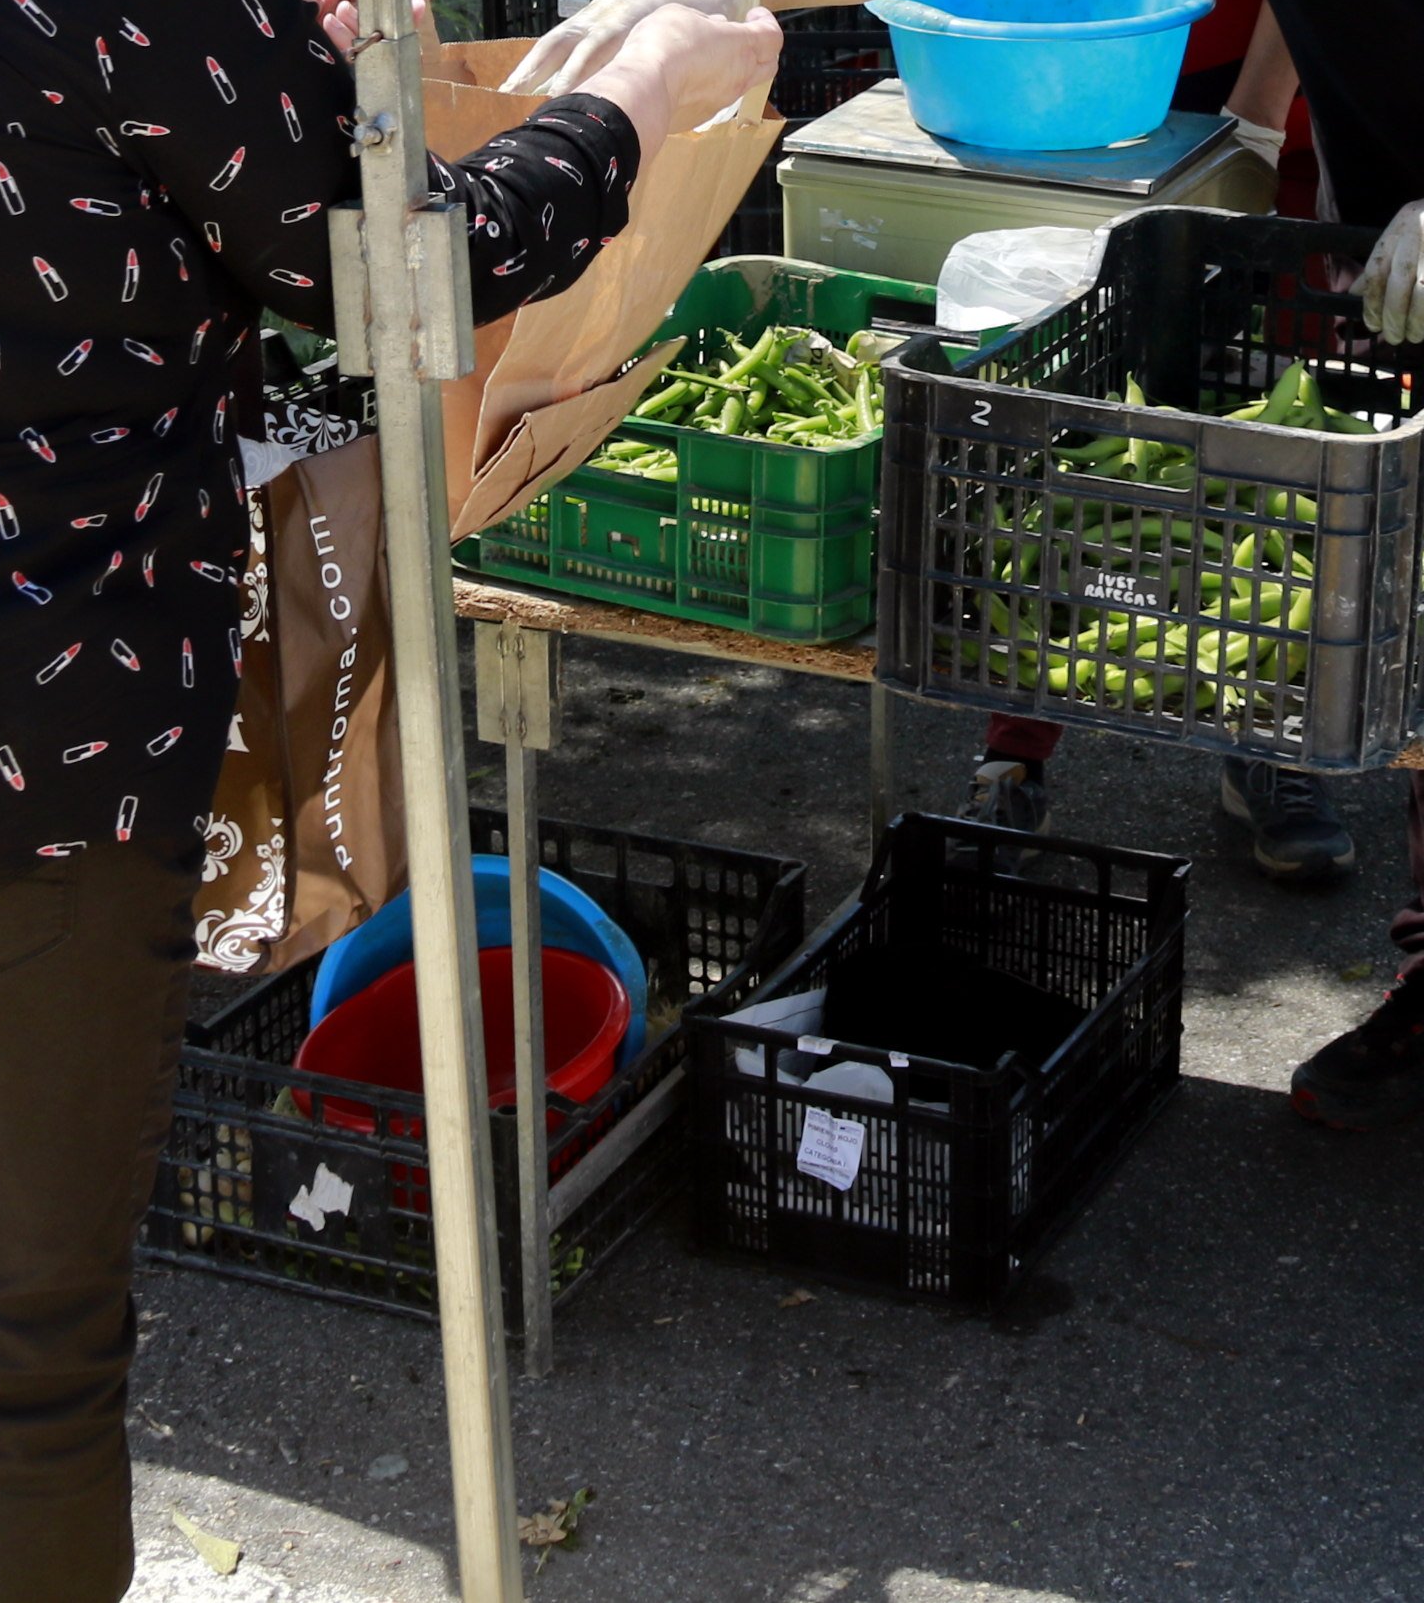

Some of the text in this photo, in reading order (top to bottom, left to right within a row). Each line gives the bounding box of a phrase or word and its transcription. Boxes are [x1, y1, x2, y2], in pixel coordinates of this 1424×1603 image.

[970, 399, 992, 428] 2
[1097, 572, 1137, 591] IVET
[308, 513, 358, 873] puntroma.com
